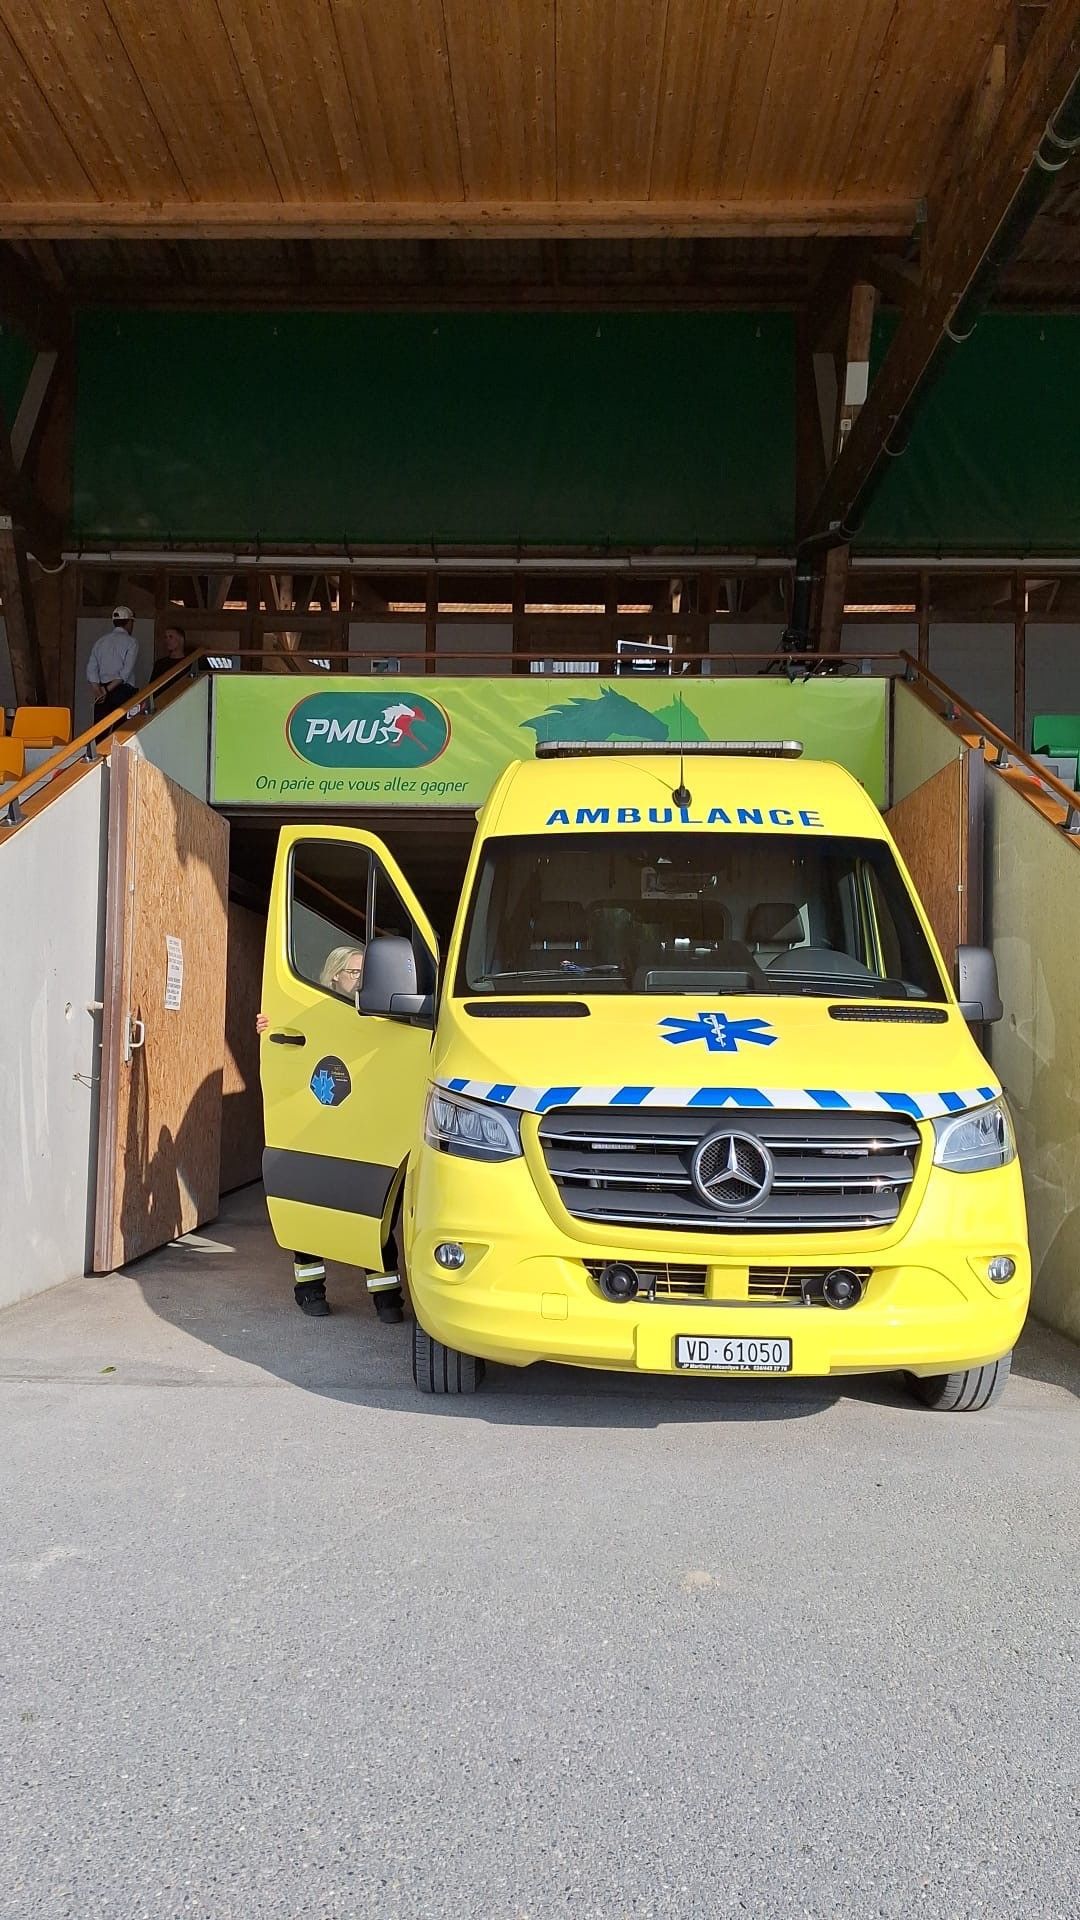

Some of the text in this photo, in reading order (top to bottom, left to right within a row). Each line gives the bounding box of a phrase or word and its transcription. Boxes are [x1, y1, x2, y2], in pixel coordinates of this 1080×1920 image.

[304, 718, 381, 743] PMU
[256, 775, 469, 796] On parie que vous allez gagner
[545, 807, 825, 828] AMBULANCE
